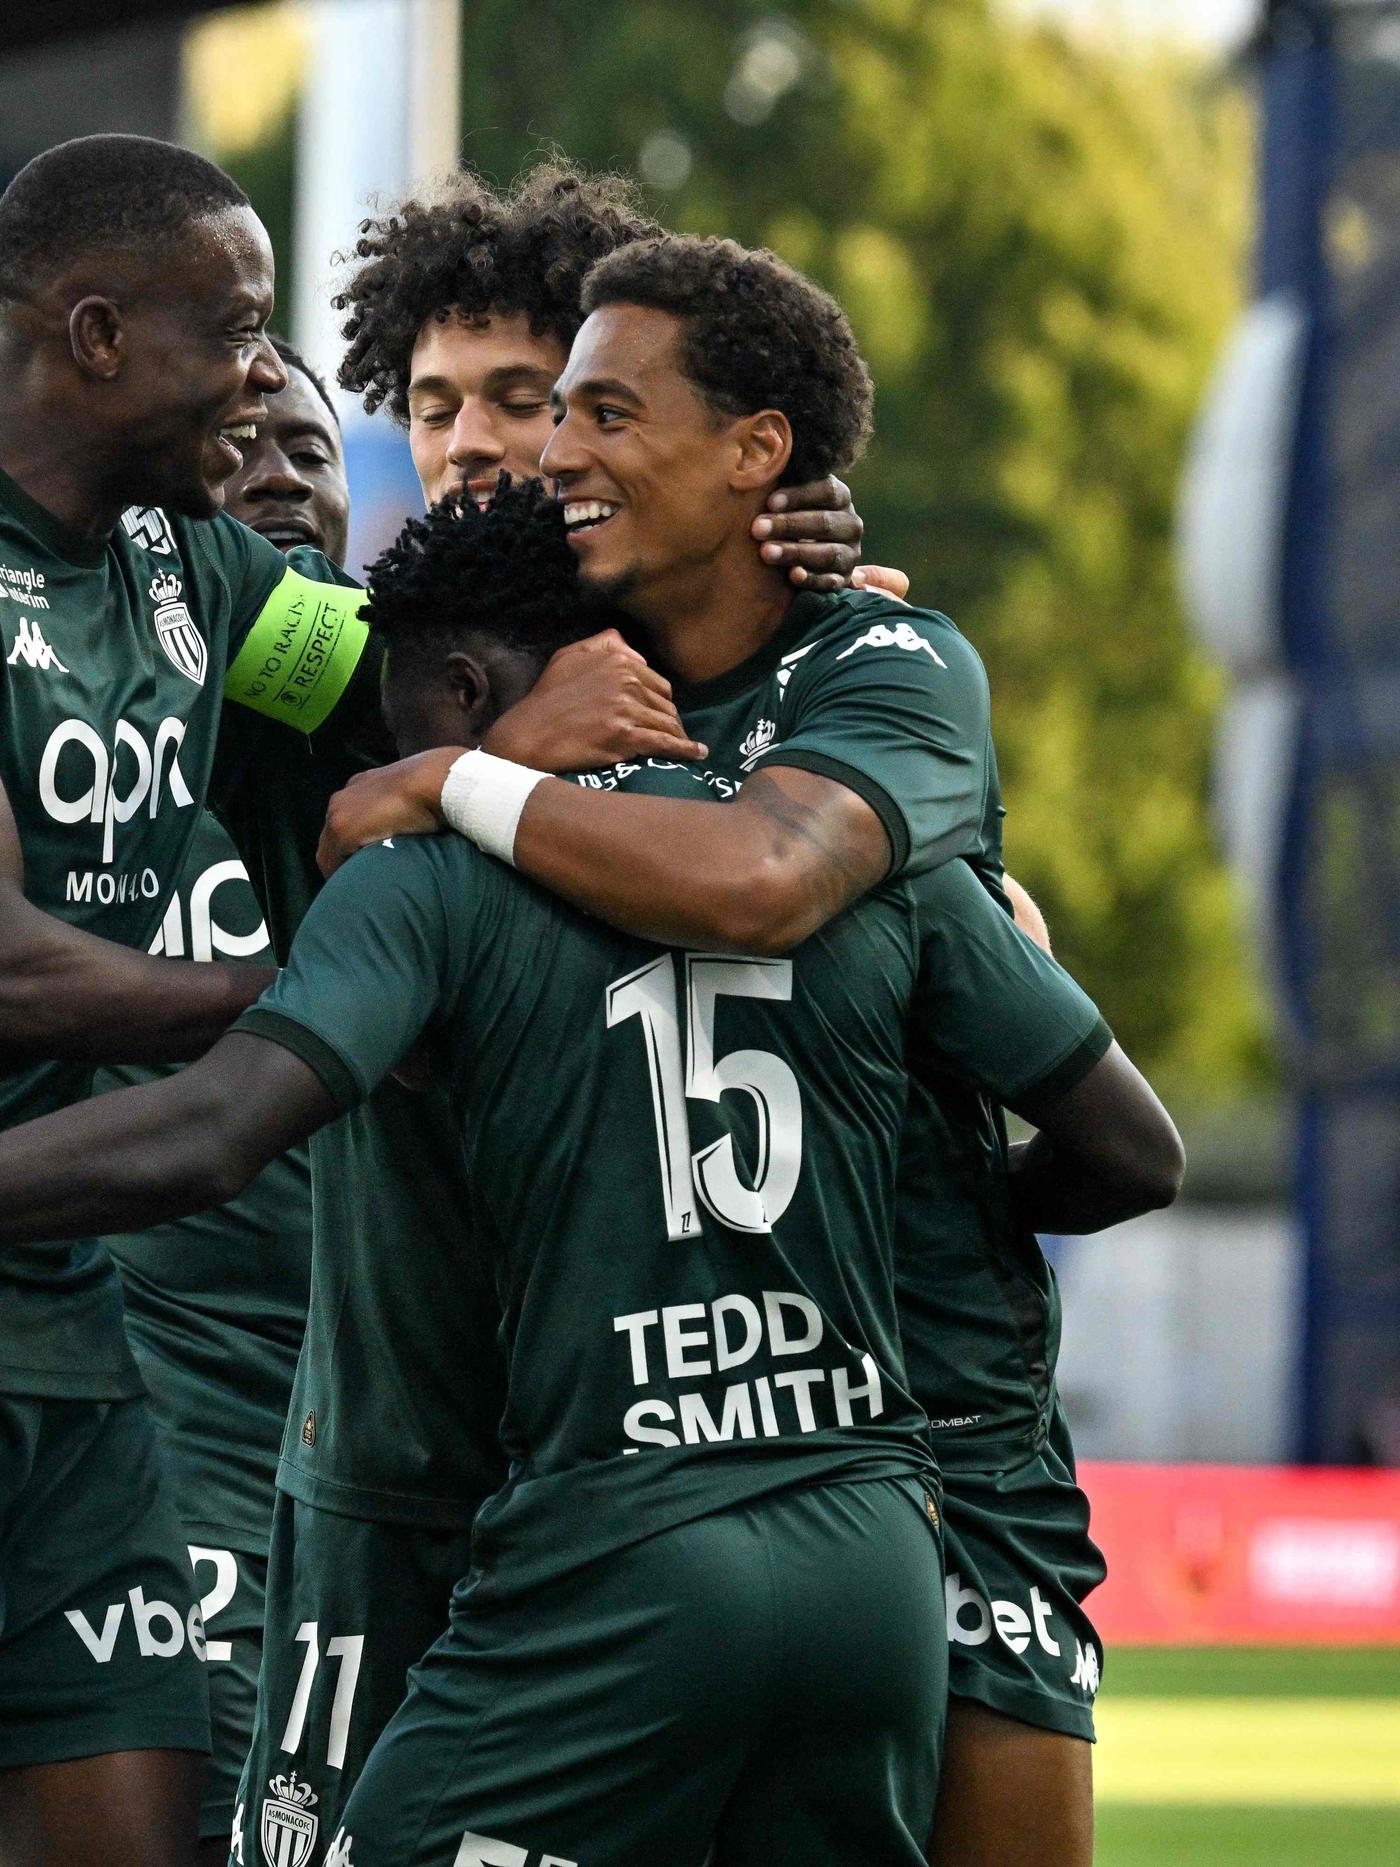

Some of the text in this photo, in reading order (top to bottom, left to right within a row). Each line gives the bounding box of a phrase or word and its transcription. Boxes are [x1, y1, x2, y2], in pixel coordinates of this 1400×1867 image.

[244, 594, 306, 698] NO TO RACIS
[295, 602, 338, 687] RESPECT
[605, 951, 803, 1242] 15
[613, 1290, 824, 1386] TEDD
[622, 1352, 884, 1456] SMITH
[927, 1414, 982, 1429] OMBAT
[945, 1572, 1061, 1658] bet
[279, 1621, 365, 1771] 11
